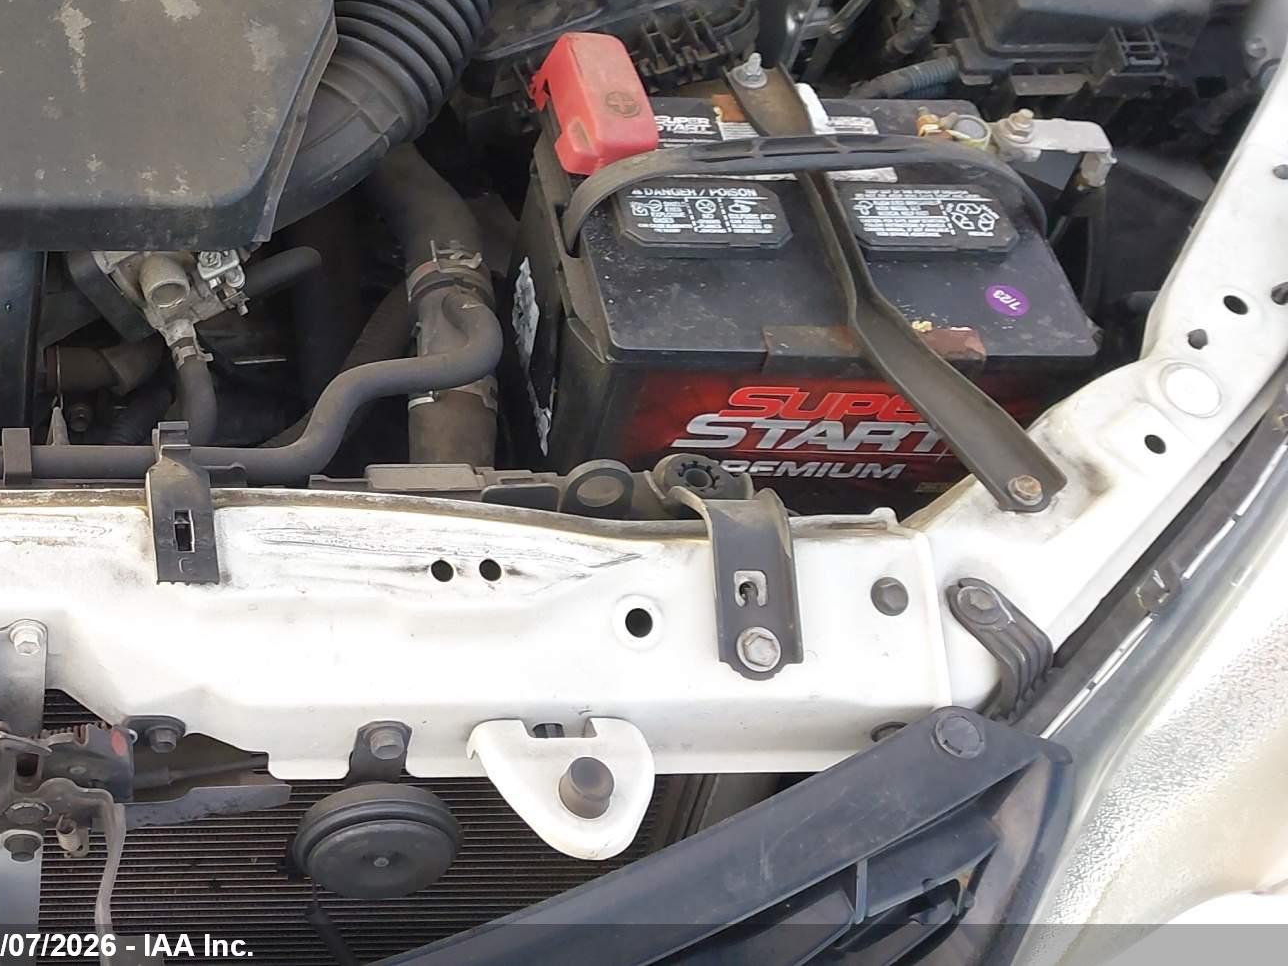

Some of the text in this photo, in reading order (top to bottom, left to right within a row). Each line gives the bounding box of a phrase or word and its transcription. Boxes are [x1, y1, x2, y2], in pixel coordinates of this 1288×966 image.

[643, 187, 697, 196] DANGER
[708, 187, 759, 197] POISON
[718, 386, 921, 422] SUPE
[670, 413, 938, 453] START
[719, 459, 908, 480] REMIUM
